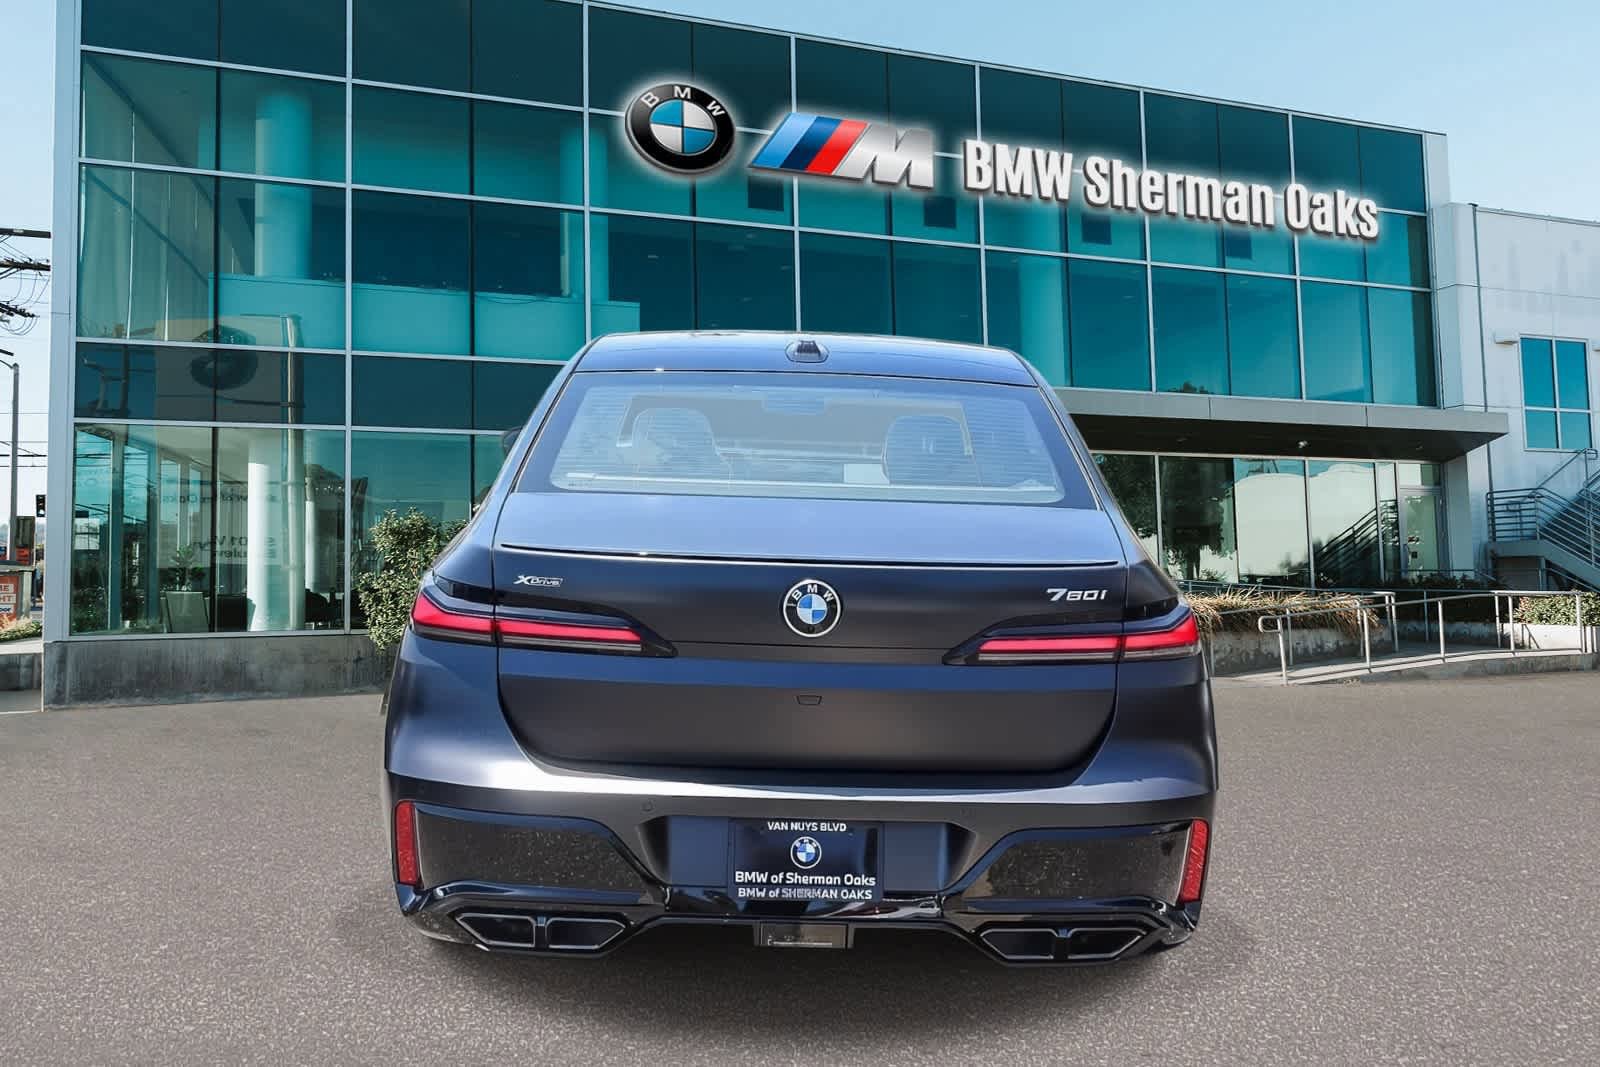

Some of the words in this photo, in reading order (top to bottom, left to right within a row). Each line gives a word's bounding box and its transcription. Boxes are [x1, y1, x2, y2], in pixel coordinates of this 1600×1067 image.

[640, 85, 726, 117] BMW
[963, 139, 1073, 201] BMW
[1083, 155, 1275, 227] Sherman
[1284, 183, 1381, 240] Oaks
[791, 584, 834, 602] BMW
[767, 821, 789, 831] VAN
[790, 821, 818, 831] NUYS
[819, 822, 847, 832] BLVD
[735, 871, 768, 883] BMW
[770, 871, 784, 883] of
[785, 872, 841, 884] Sherman
[844, 873, 876, 886] Oaks
[738, 888, 766, 898] BMW
[768, 888, 780, 898] of
[781, 888, 838, 899] SHERMAN
[840, 889, 873, 900] OAKS
